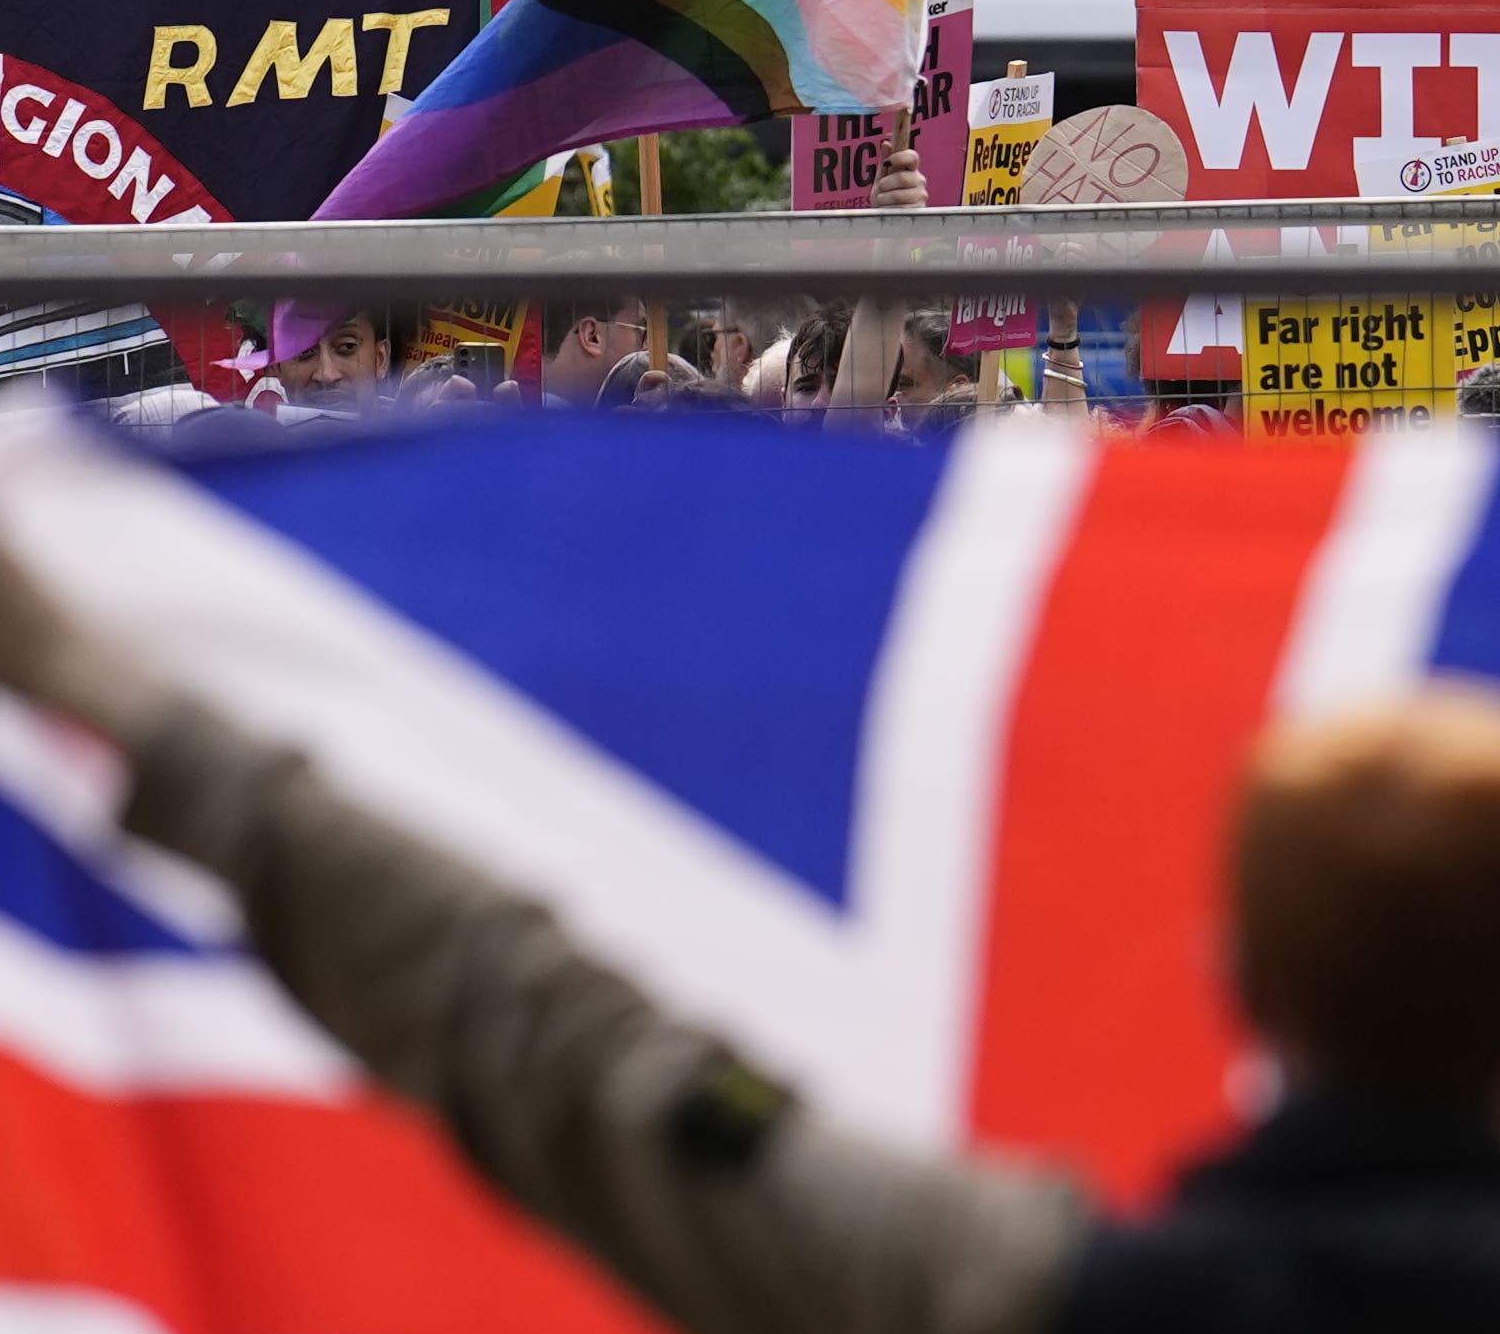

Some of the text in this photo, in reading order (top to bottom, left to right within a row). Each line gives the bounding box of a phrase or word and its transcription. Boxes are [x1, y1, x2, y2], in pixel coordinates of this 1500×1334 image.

[142, 8, 450, 111] RMT
[1003, 87, 1029, 103] STAND
[1003, 104, 1015, 119] TO
[1069, 107, 1161, 188] NO
[1434, 148, 1500, 171] STAND UP
[1437, 170, 1454, 186] TO
[1258, 304, 1425, 351] Far right
[1259, 353, 1397, 390] are not
